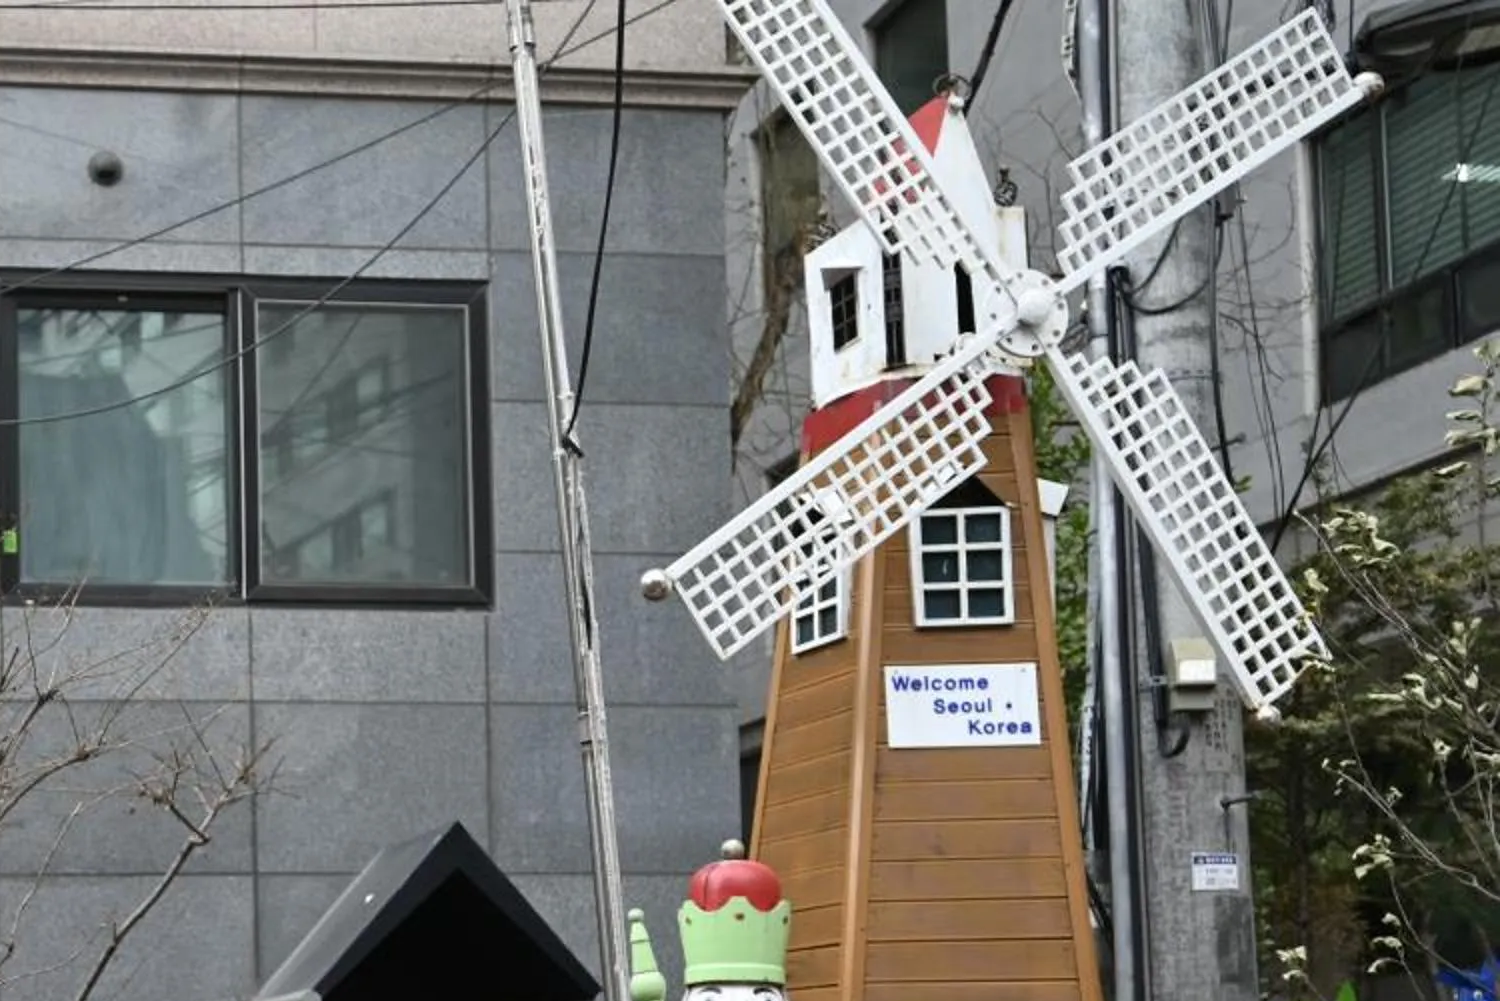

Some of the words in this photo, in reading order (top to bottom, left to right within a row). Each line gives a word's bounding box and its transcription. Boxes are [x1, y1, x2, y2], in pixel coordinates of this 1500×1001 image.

[891, 675, 989, 692] Welcome
[933, 697, 993, 714] Seoul
[967, 719, 1033, 735] Korea
